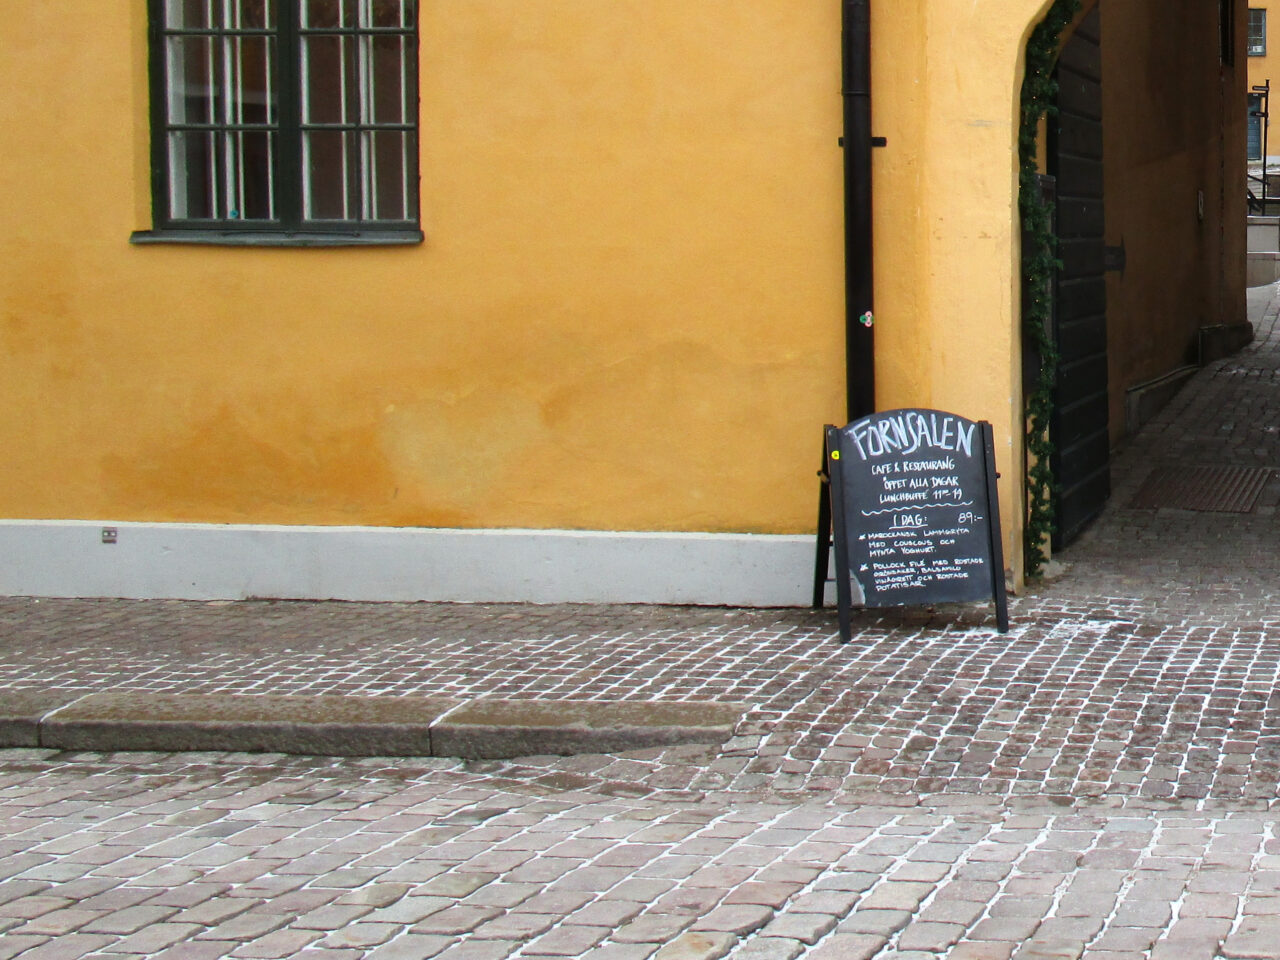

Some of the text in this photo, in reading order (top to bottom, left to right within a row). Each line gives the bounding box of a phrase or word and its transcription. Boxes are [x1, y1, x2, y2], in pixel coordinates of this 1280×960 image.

[845, 411, 976, 461] FORNSALEN
[903, 456, 955, 473] RESTAURANG
[909, 478, 929, 489] ALLA
[930, 476, 960, 489] DAGAR
[957, 511, 983, 525] 89:-
[868, 540, 886, 549] MED
[893, 539, 933, 547] COUSCOUS
[869, 548, 896, 558] MYNTA
[873, 561, 906, 571] POLLOCK
